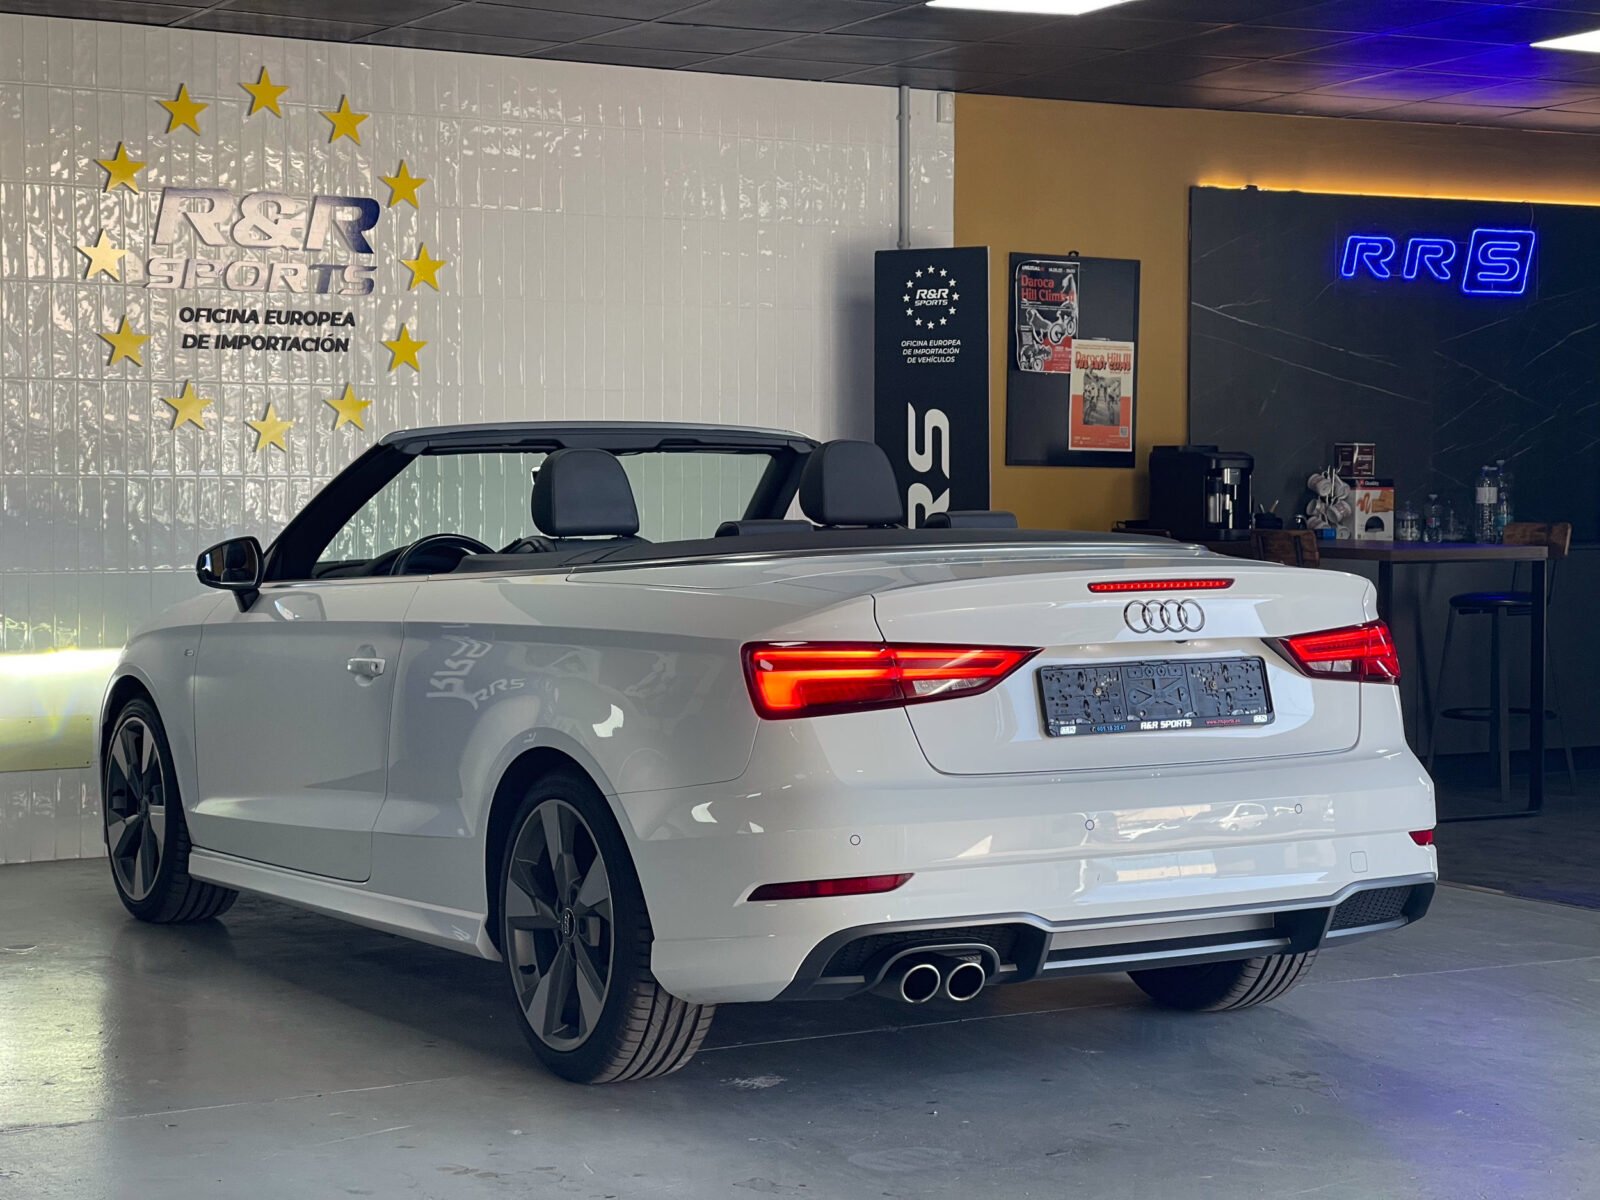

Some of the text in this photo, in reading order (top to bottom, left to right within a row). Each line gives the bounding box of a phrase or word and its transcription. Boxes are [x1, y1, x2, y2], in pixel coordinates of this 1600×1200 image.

[153, 187, 381, 254] R&R
[1341, 229, 1535, 294] RRS
[144, 258, 377, 296] SPORTS
[1021, 274, 1054, 289] Daroca
[916, 288, 949, 299] R&R
[1021, 287, 1036, 301] Hill
[179, 307, 355, 327] OFICINA EUROPEA
[182, 333, 349, 353] DE IMPORTACIÓN
[929, 339, 961, 347] EUROPEA
[913, 347, 960, 355] IMPORTACIÓN
[918, 355, 955, 363] VEHÍCULOS
[1140, 719, 1192, 730] R&R SPORTS
